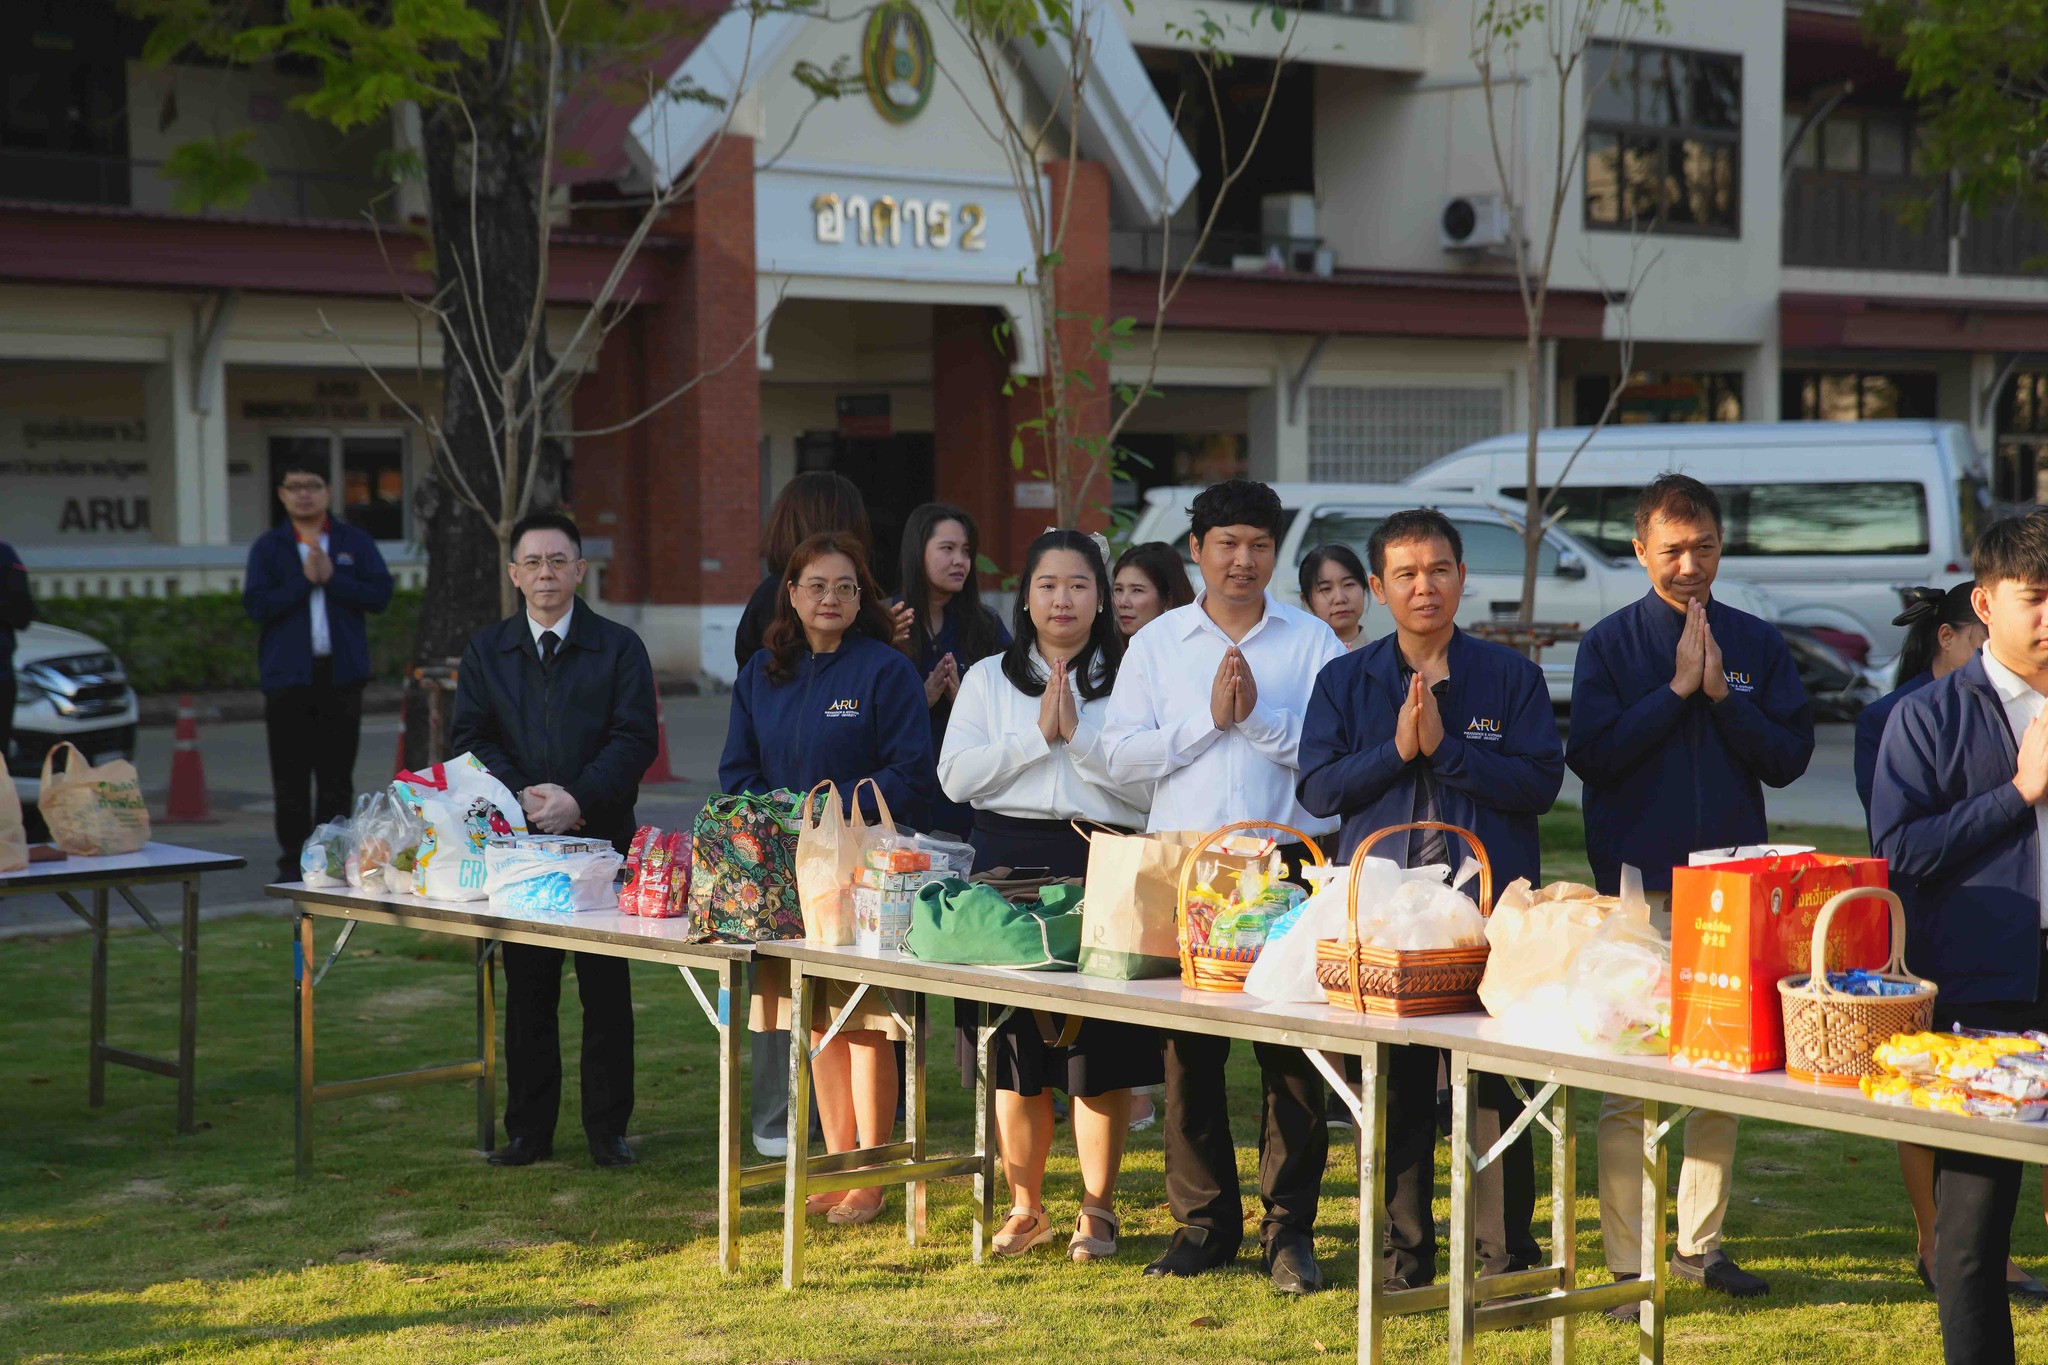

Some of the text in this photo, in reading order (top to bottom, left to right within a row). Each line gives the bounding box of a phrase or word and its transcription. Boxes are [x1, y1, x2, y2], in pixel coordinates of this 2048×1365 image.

[813, 193, 986, 250] อาคาร 2
[829, 699, 858, 710] ARU
[1467, 716, 1500, 731] ARU
[1093, 925, 1107, 945] R
